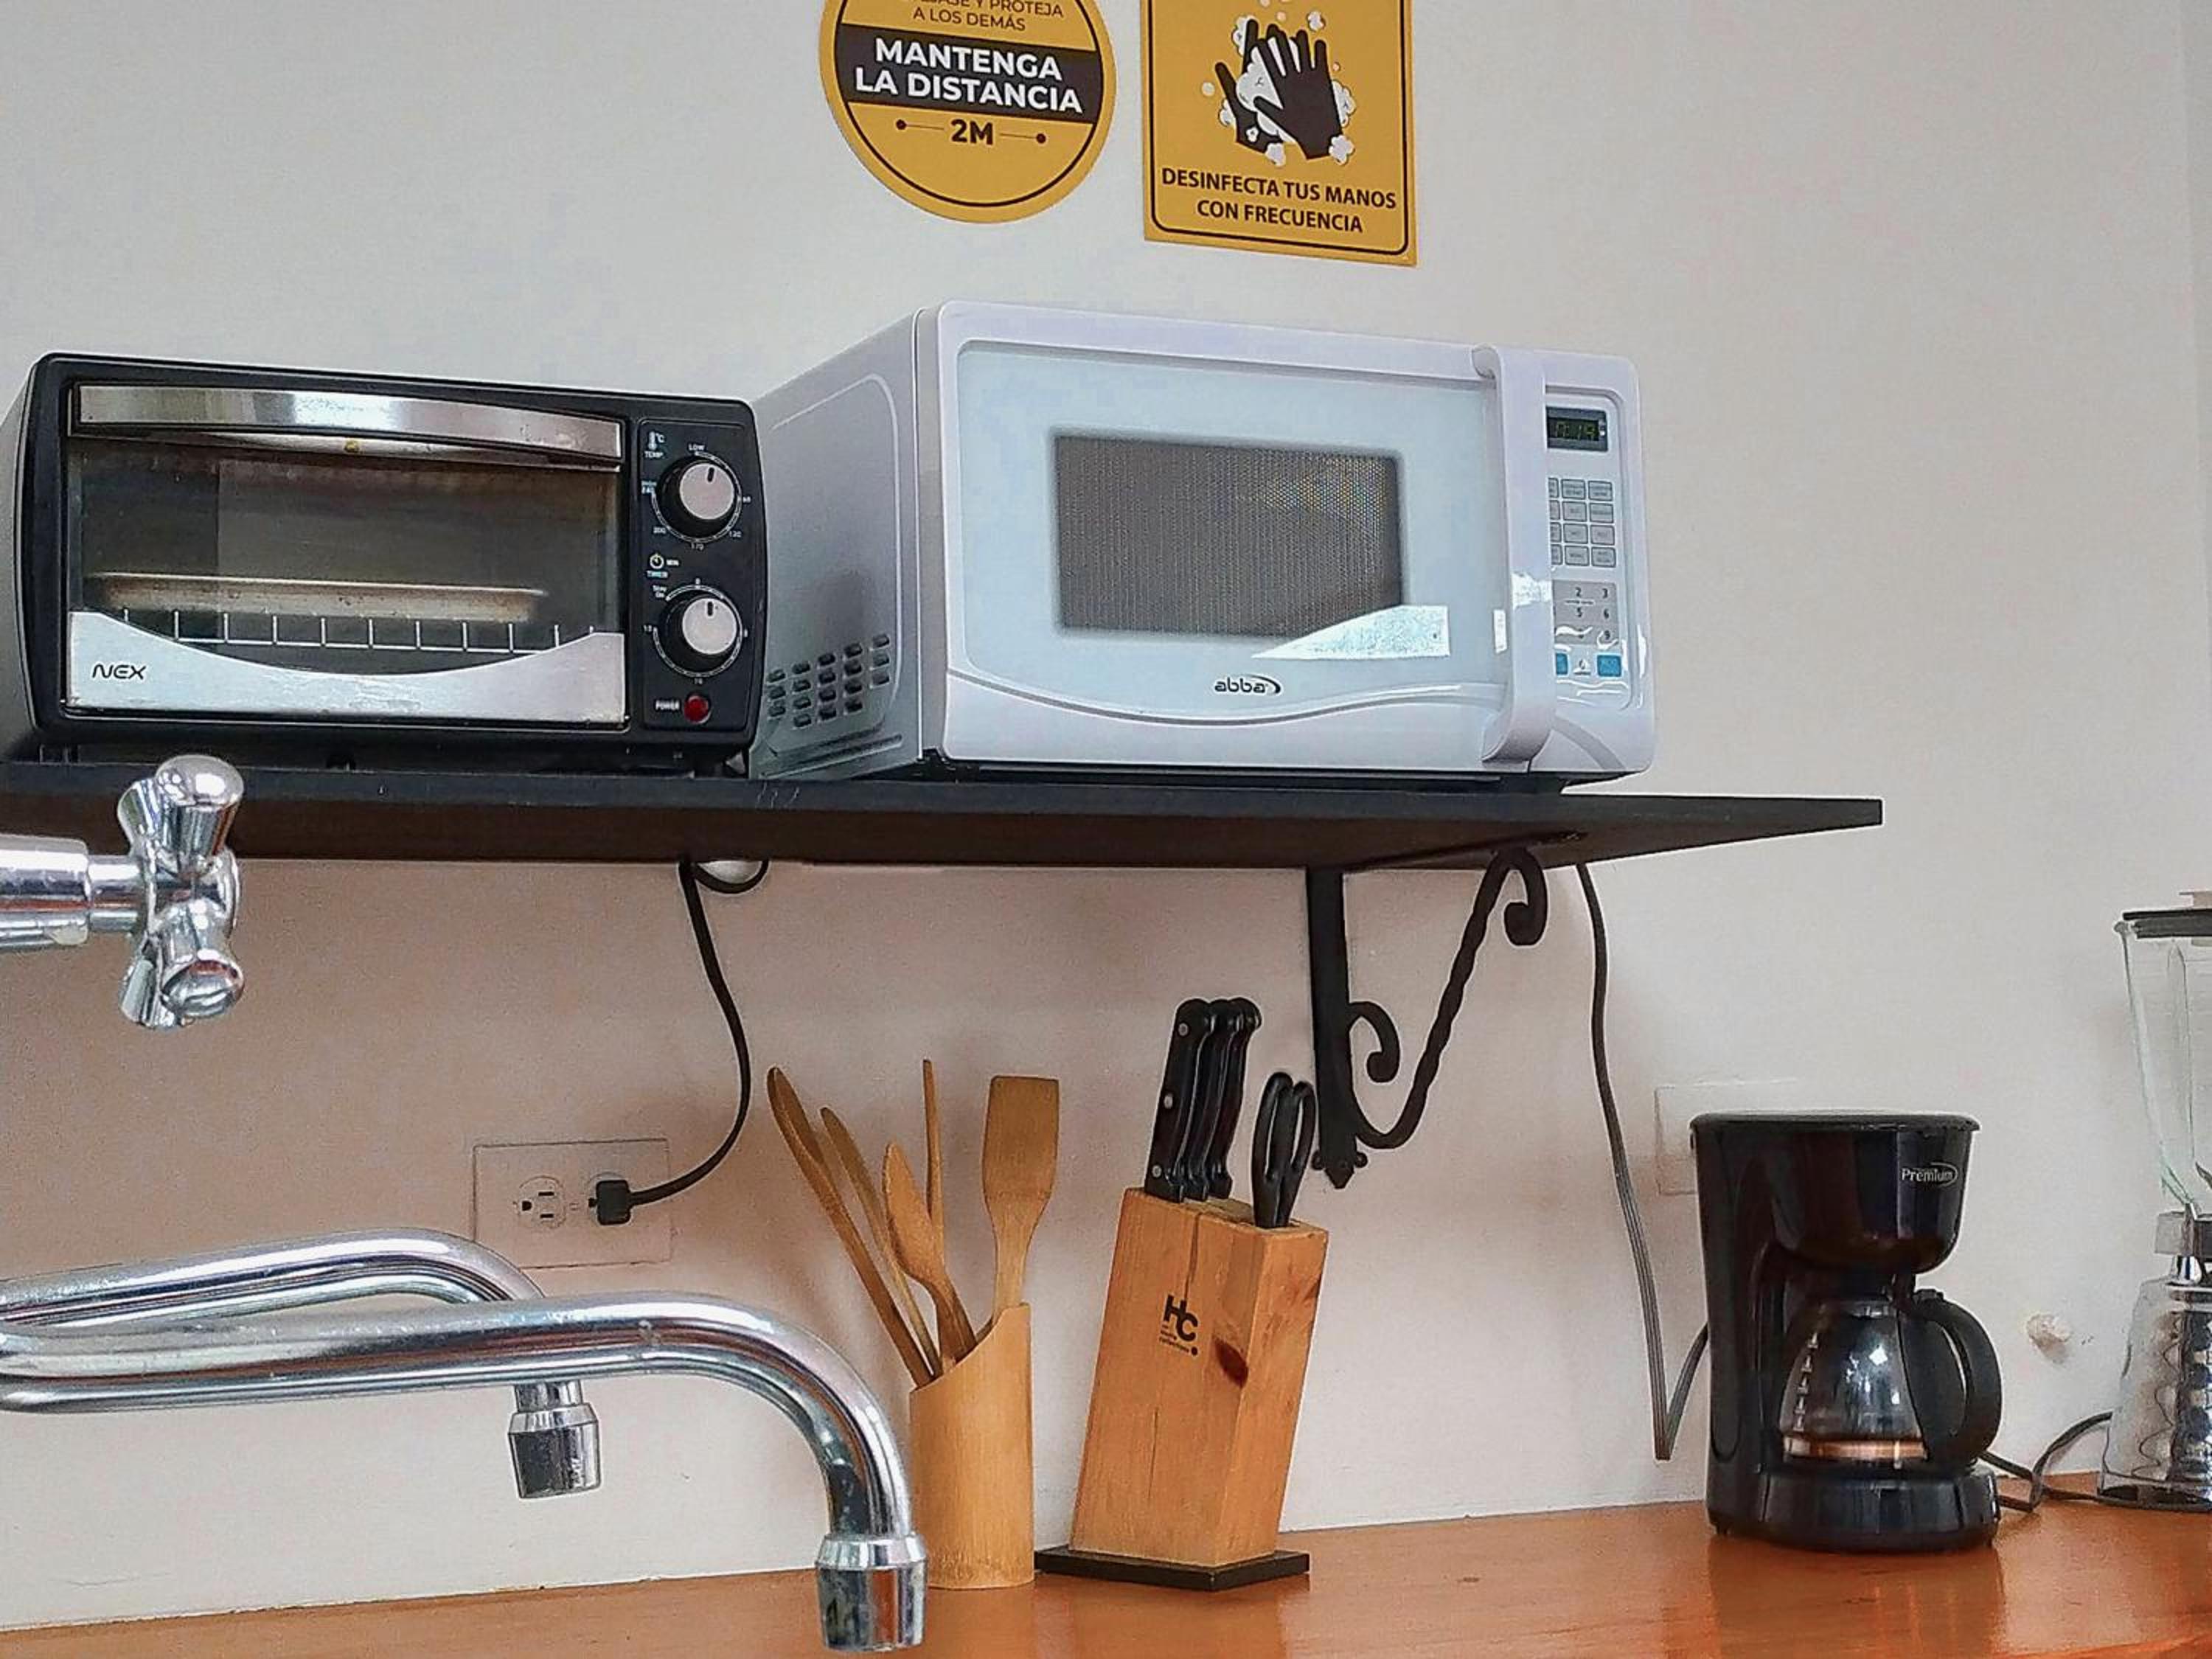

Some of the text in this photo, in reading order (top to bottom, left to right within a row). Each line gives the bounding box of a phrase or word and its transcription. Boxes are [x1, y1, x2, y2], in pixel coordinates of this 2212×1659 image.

[913, 7, 1026, 31] A LOS DEMÁS
[990, 0, 1063, 18] PROTEJA
[875, 38, 1062, 80] MANTENGA
[855, 67, 1082, 113] LA DISTANCIA
[950, 119, 993, 145] 2M
[1162, 168, 1397, 209] DESINFECTA TUS MANOS
[1197, 200, 1363, 232] CON FRECUENCIA
[92, 663, 146, 680] NEX
[1214, 677, 1266, 693] abba
[1902, 1167, 1954, 1183] Premium
